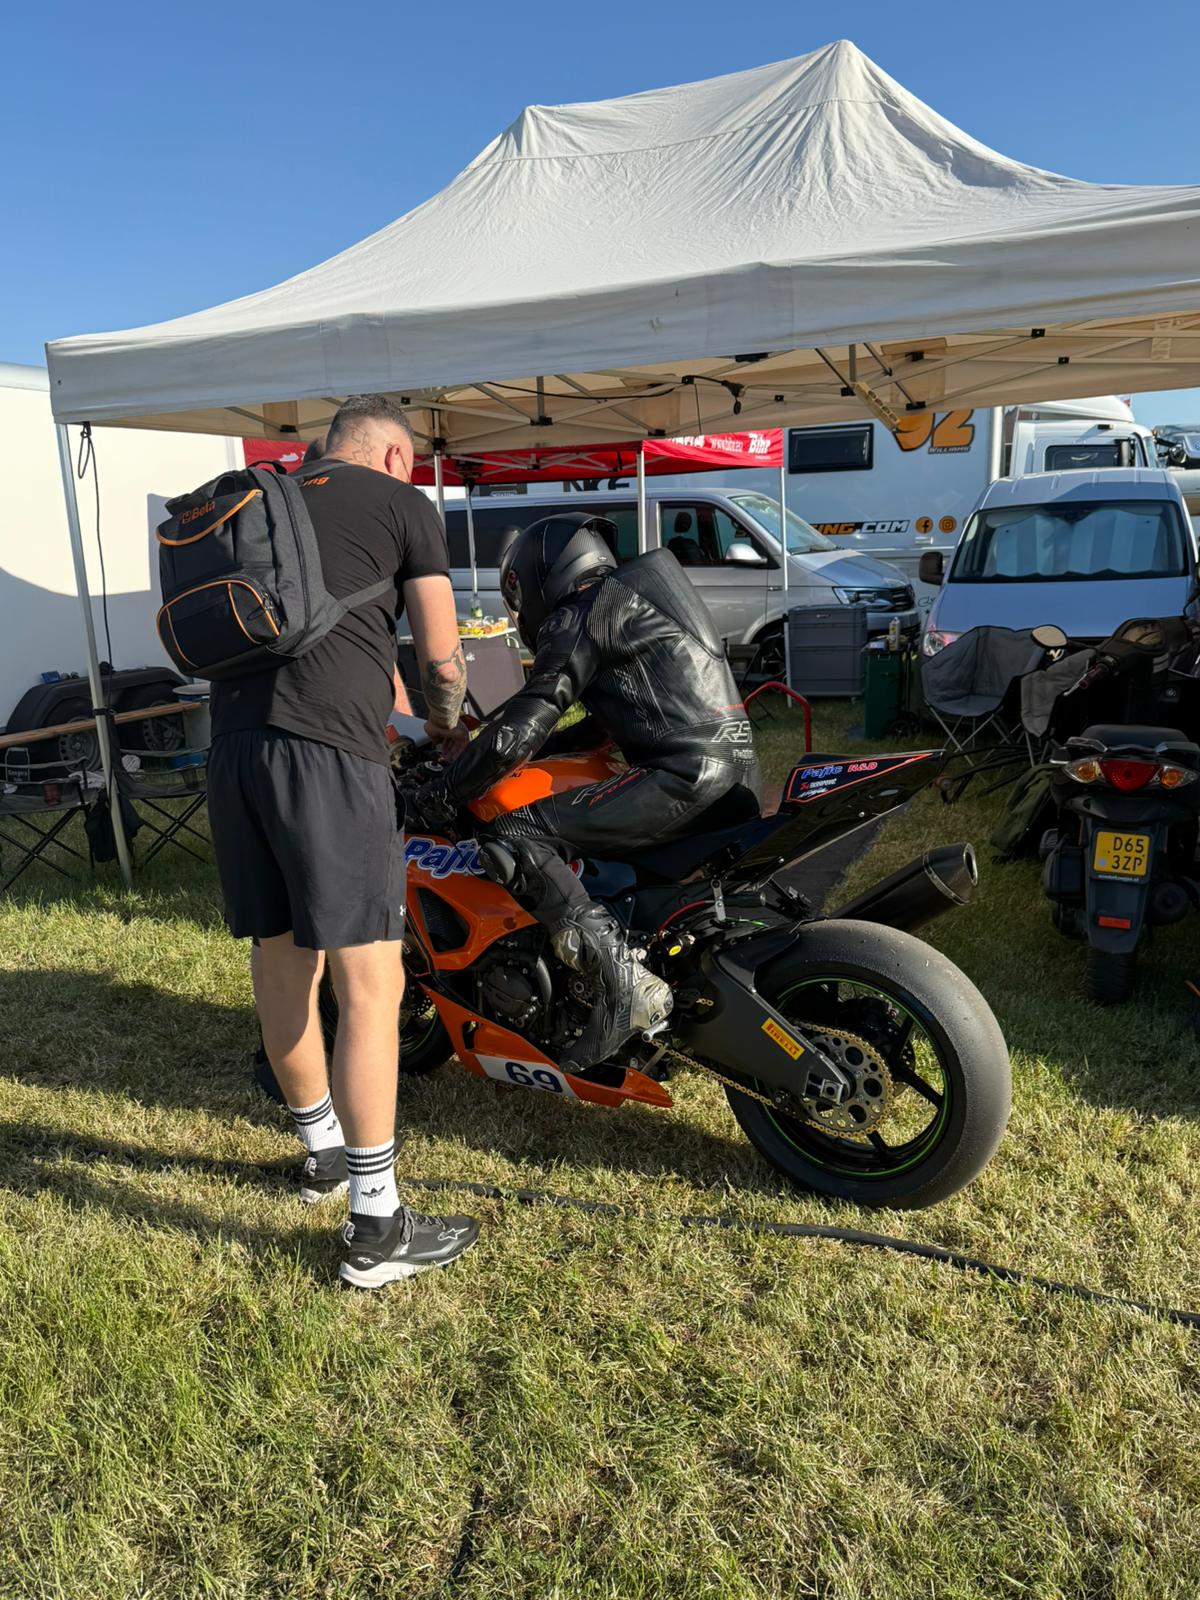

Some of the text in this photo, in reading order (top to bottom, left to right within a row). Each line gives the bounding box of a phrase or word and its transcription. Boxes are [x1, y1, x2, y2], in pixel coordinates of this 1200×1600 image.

[711, 720, 753, 743] RS
[1113, 836, 1144, 853] D65
[1111, 855, 1143, 871] 3ZP
[505, 1061, 563, 1093] 69
